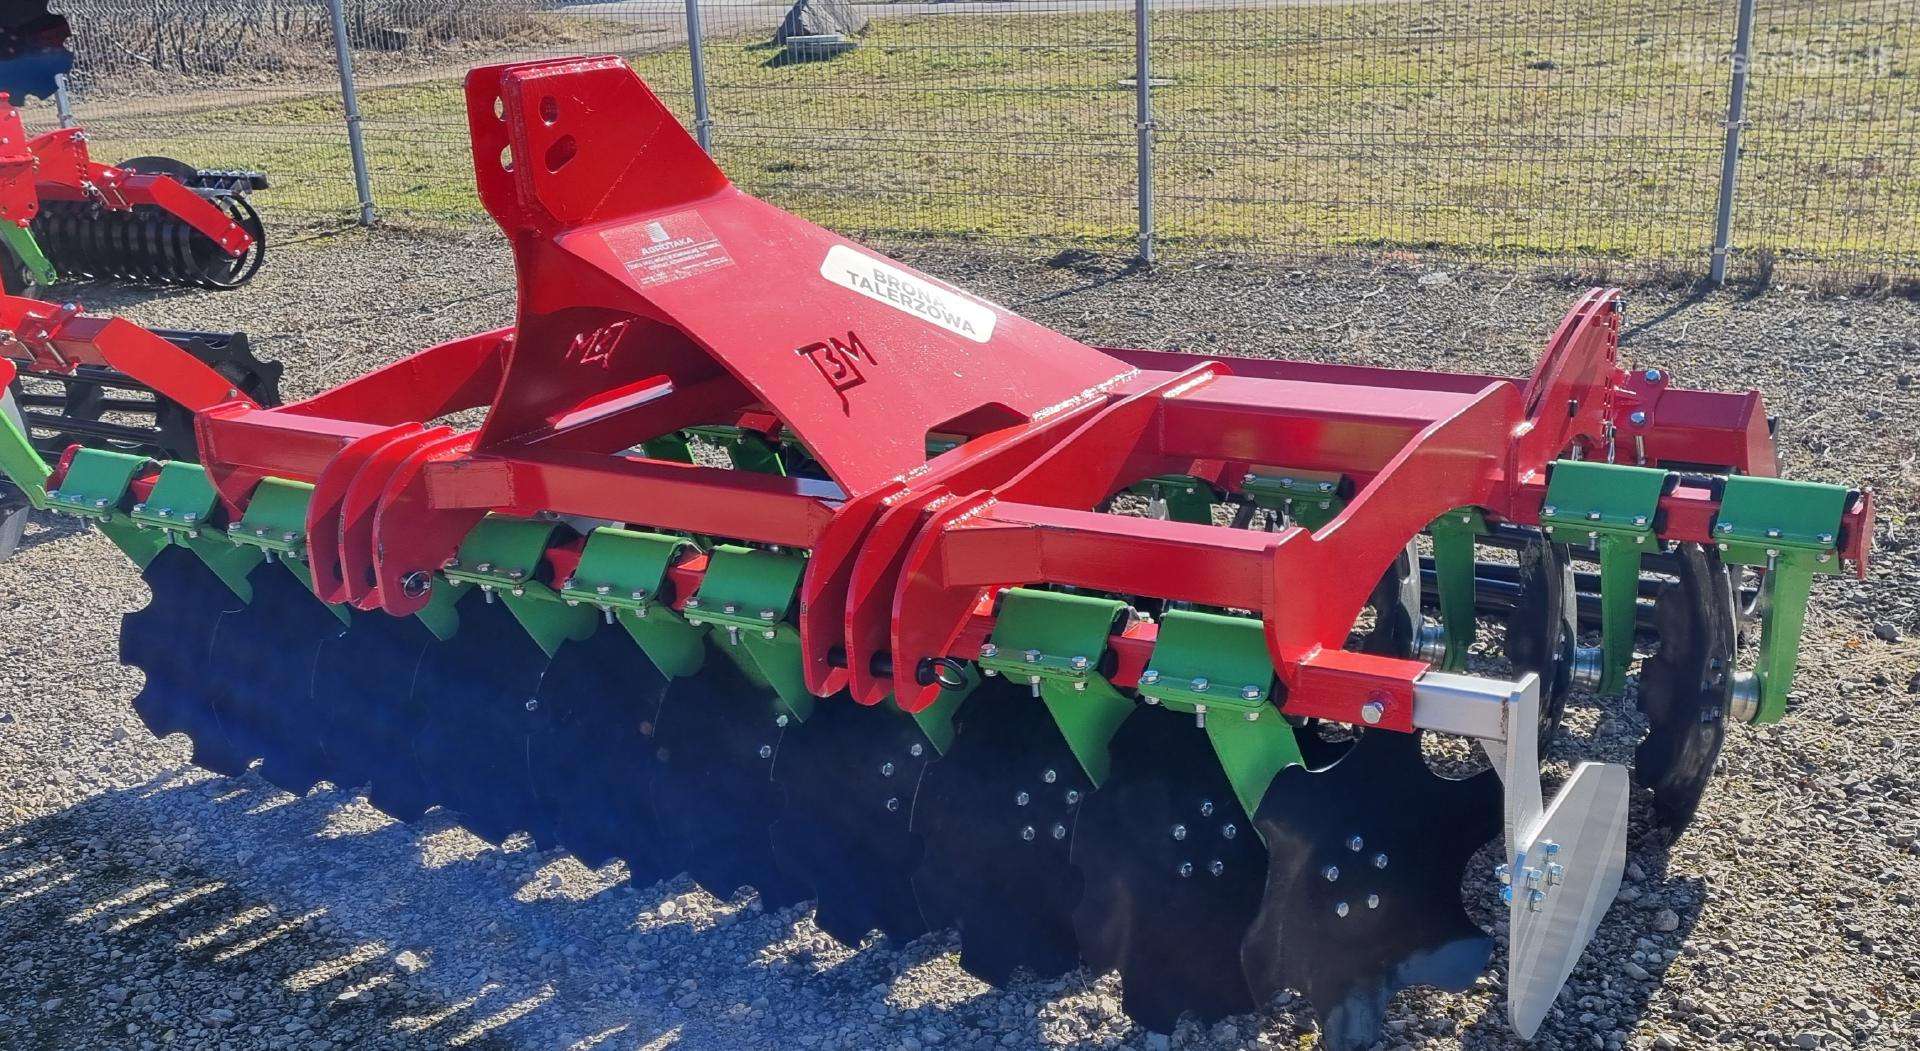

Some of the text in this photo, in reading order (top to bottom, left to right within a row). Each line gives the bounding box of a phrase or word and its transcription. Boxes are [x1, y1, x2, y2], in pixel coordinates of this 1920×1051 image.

[641, 237, 694, 255] AGROTAKA
[846, 269, 977, 335] TALERZOWA
[873, 268, 947, 310] BRONA
